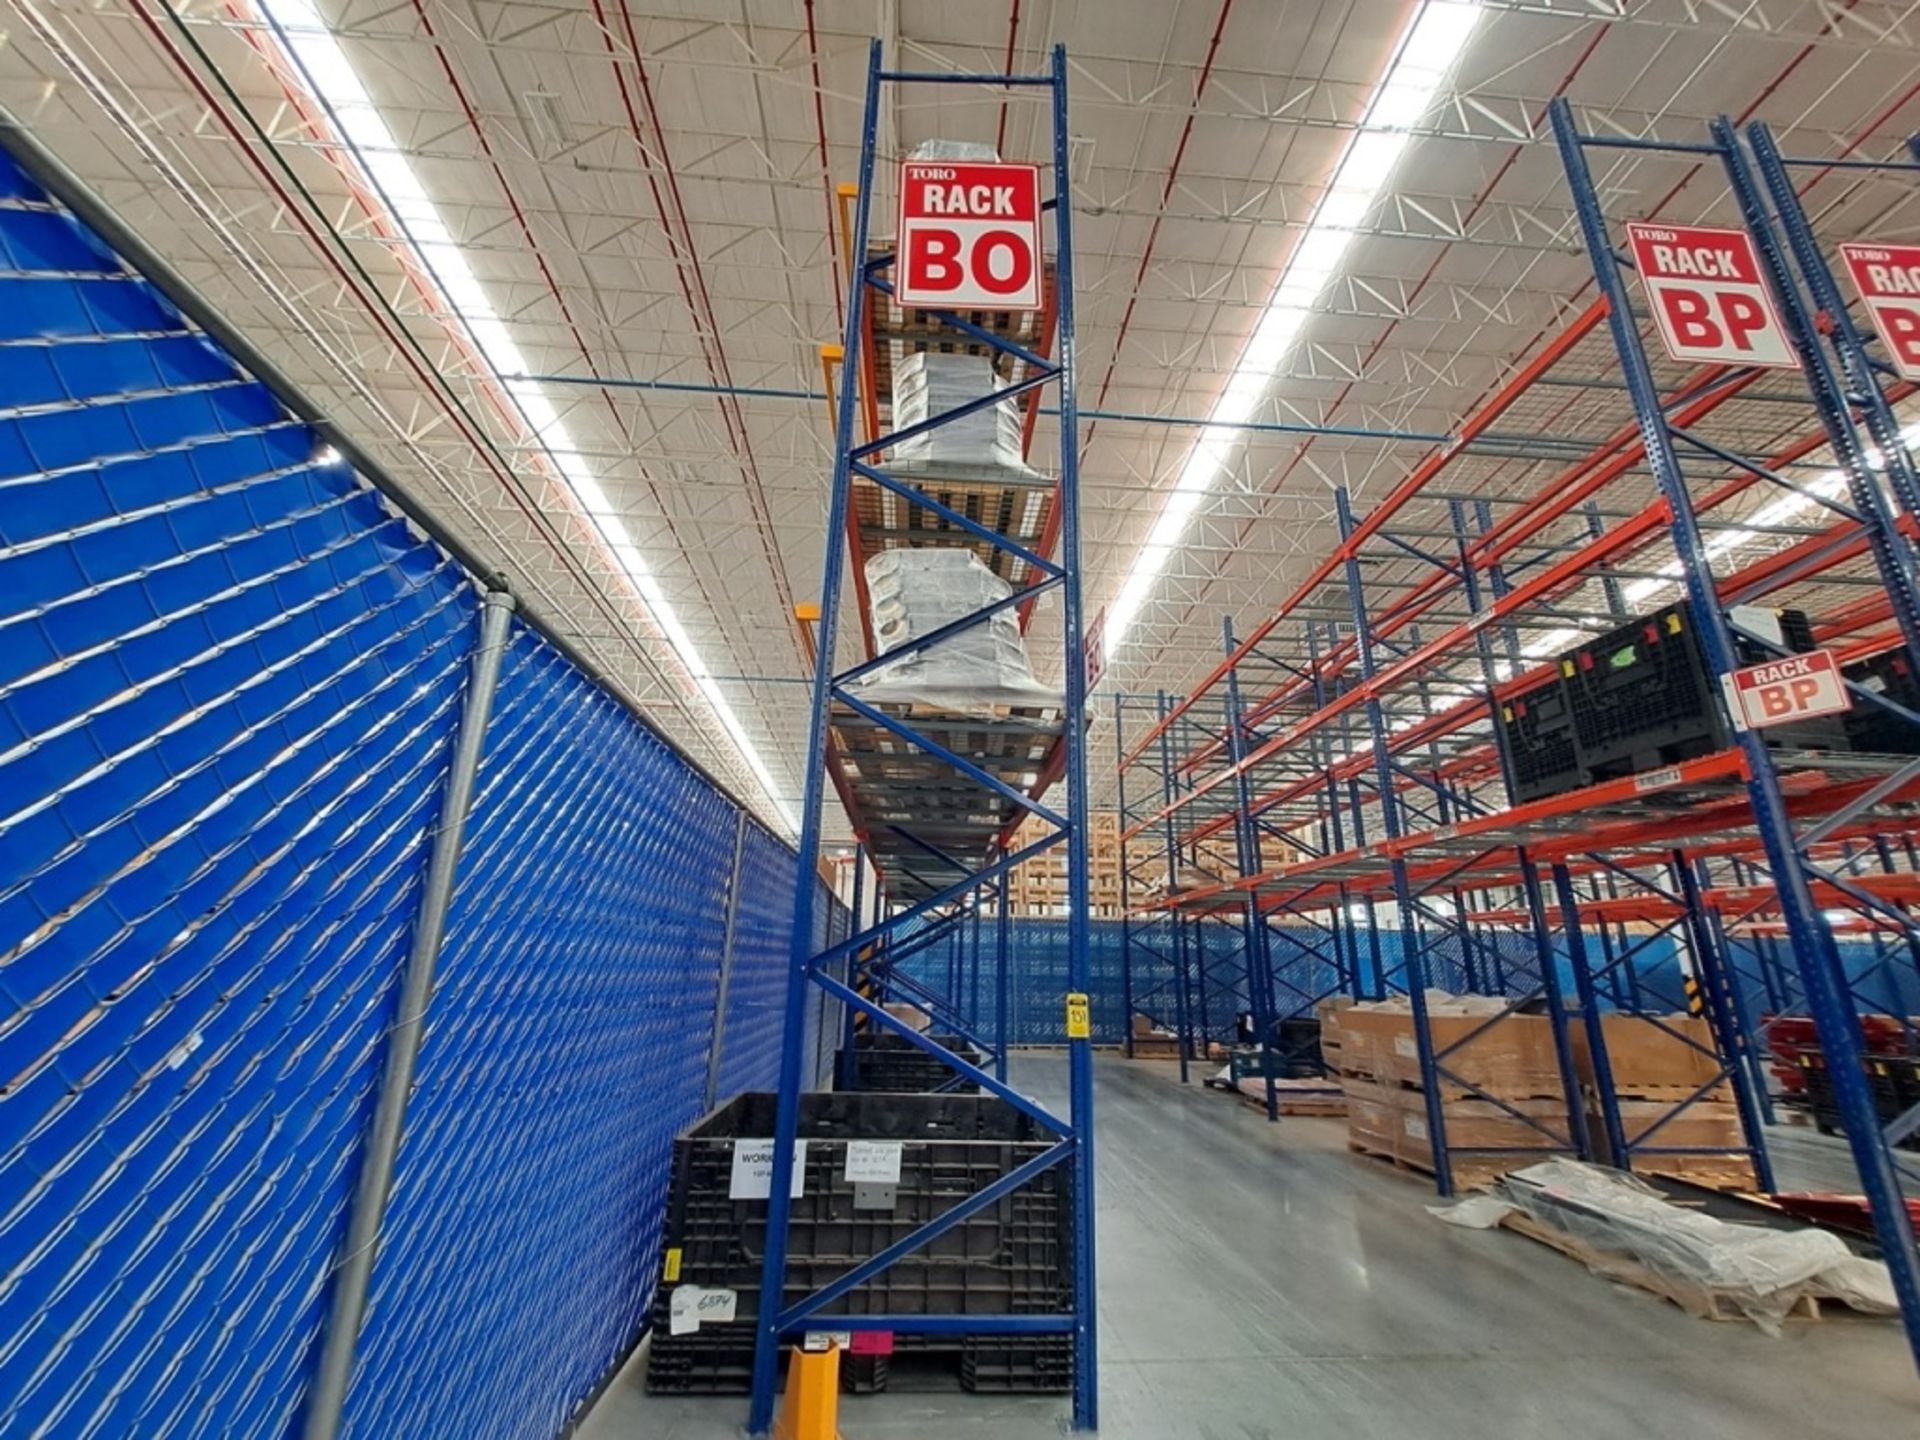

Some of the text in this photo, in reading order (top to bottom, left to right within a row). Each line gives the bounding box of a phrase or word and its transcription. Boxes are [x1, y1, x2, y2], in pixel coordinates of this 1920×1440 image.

[909, 168, 956, 180] TORO
[923, 184, 1016, 216] RACK
[1633, 228, 1677, 242] TORO
[908, 229, 1032, 295] BO
[1652, 245, 1742, 279] RACK
[1847, 249, 1891, 261] TORO
[1659, 288, 1767, 351] BP
[1752, 658, 1812, 685] RACK
[1759, 678, 1819, 717] BP
